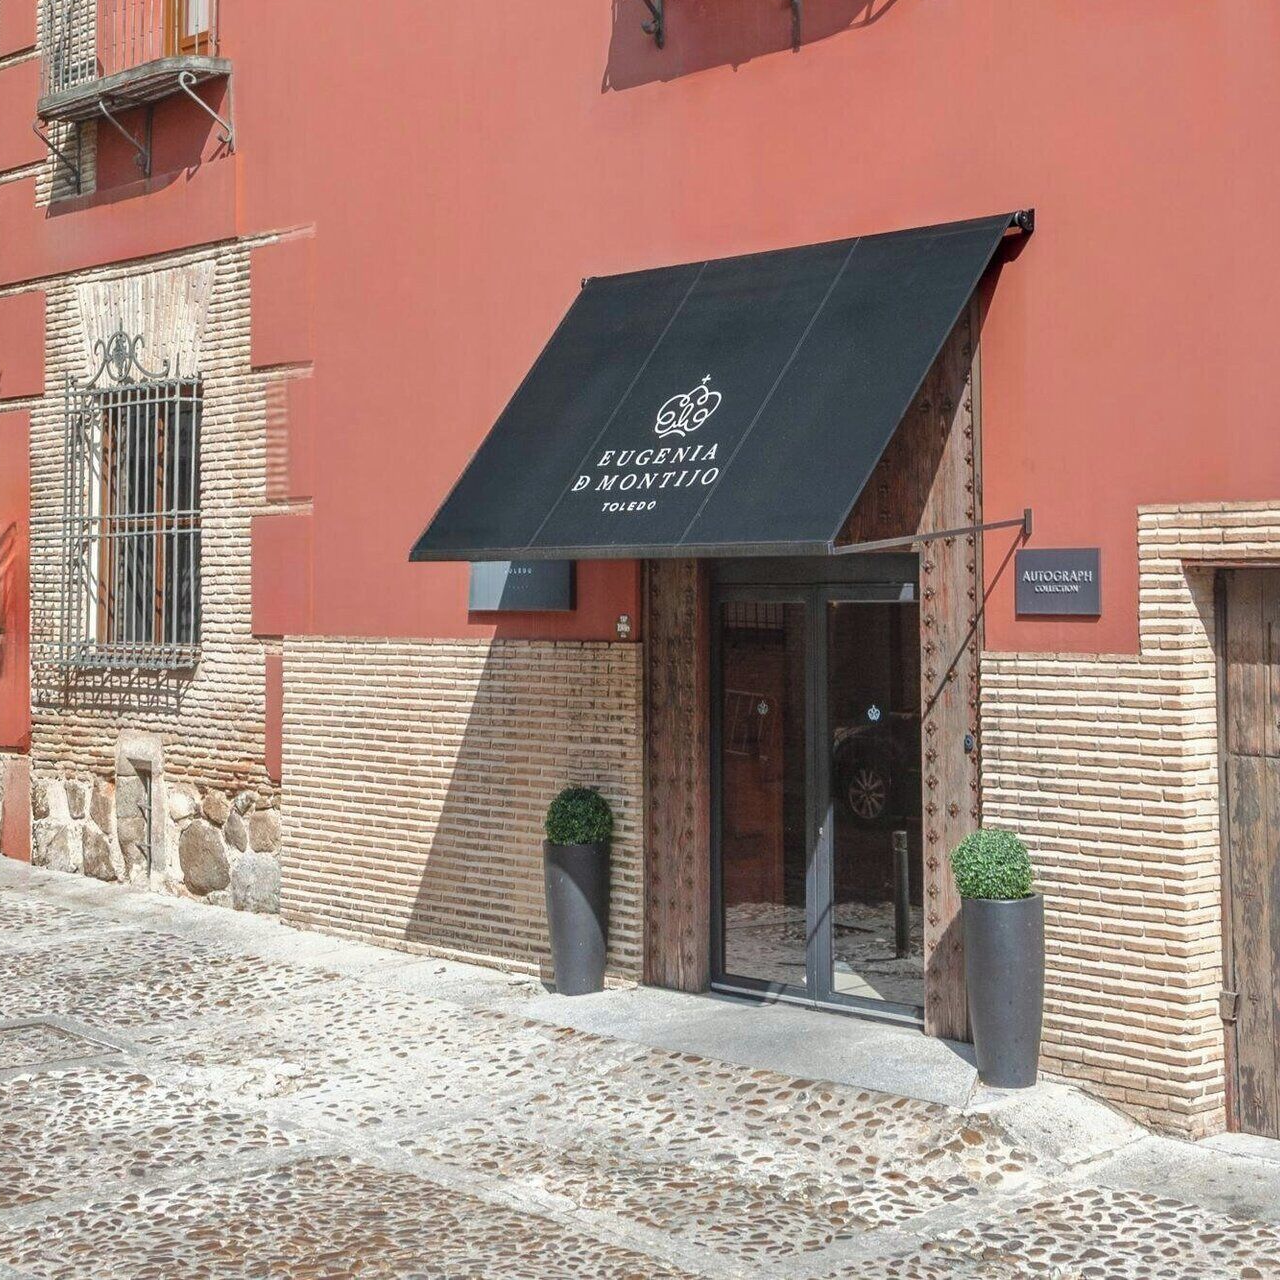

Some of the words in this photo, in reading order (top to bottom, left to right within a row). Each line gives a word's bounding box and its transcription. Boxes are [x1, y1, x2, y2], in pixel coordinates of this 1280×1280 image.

[597, 443, 718, 467] EUGENIA
[595, 468, 719, 491] MONTIJO
[602, 501, 657, 512] TOLEDO
[1022, 570, 1093, 582] AUTOGRAPH
